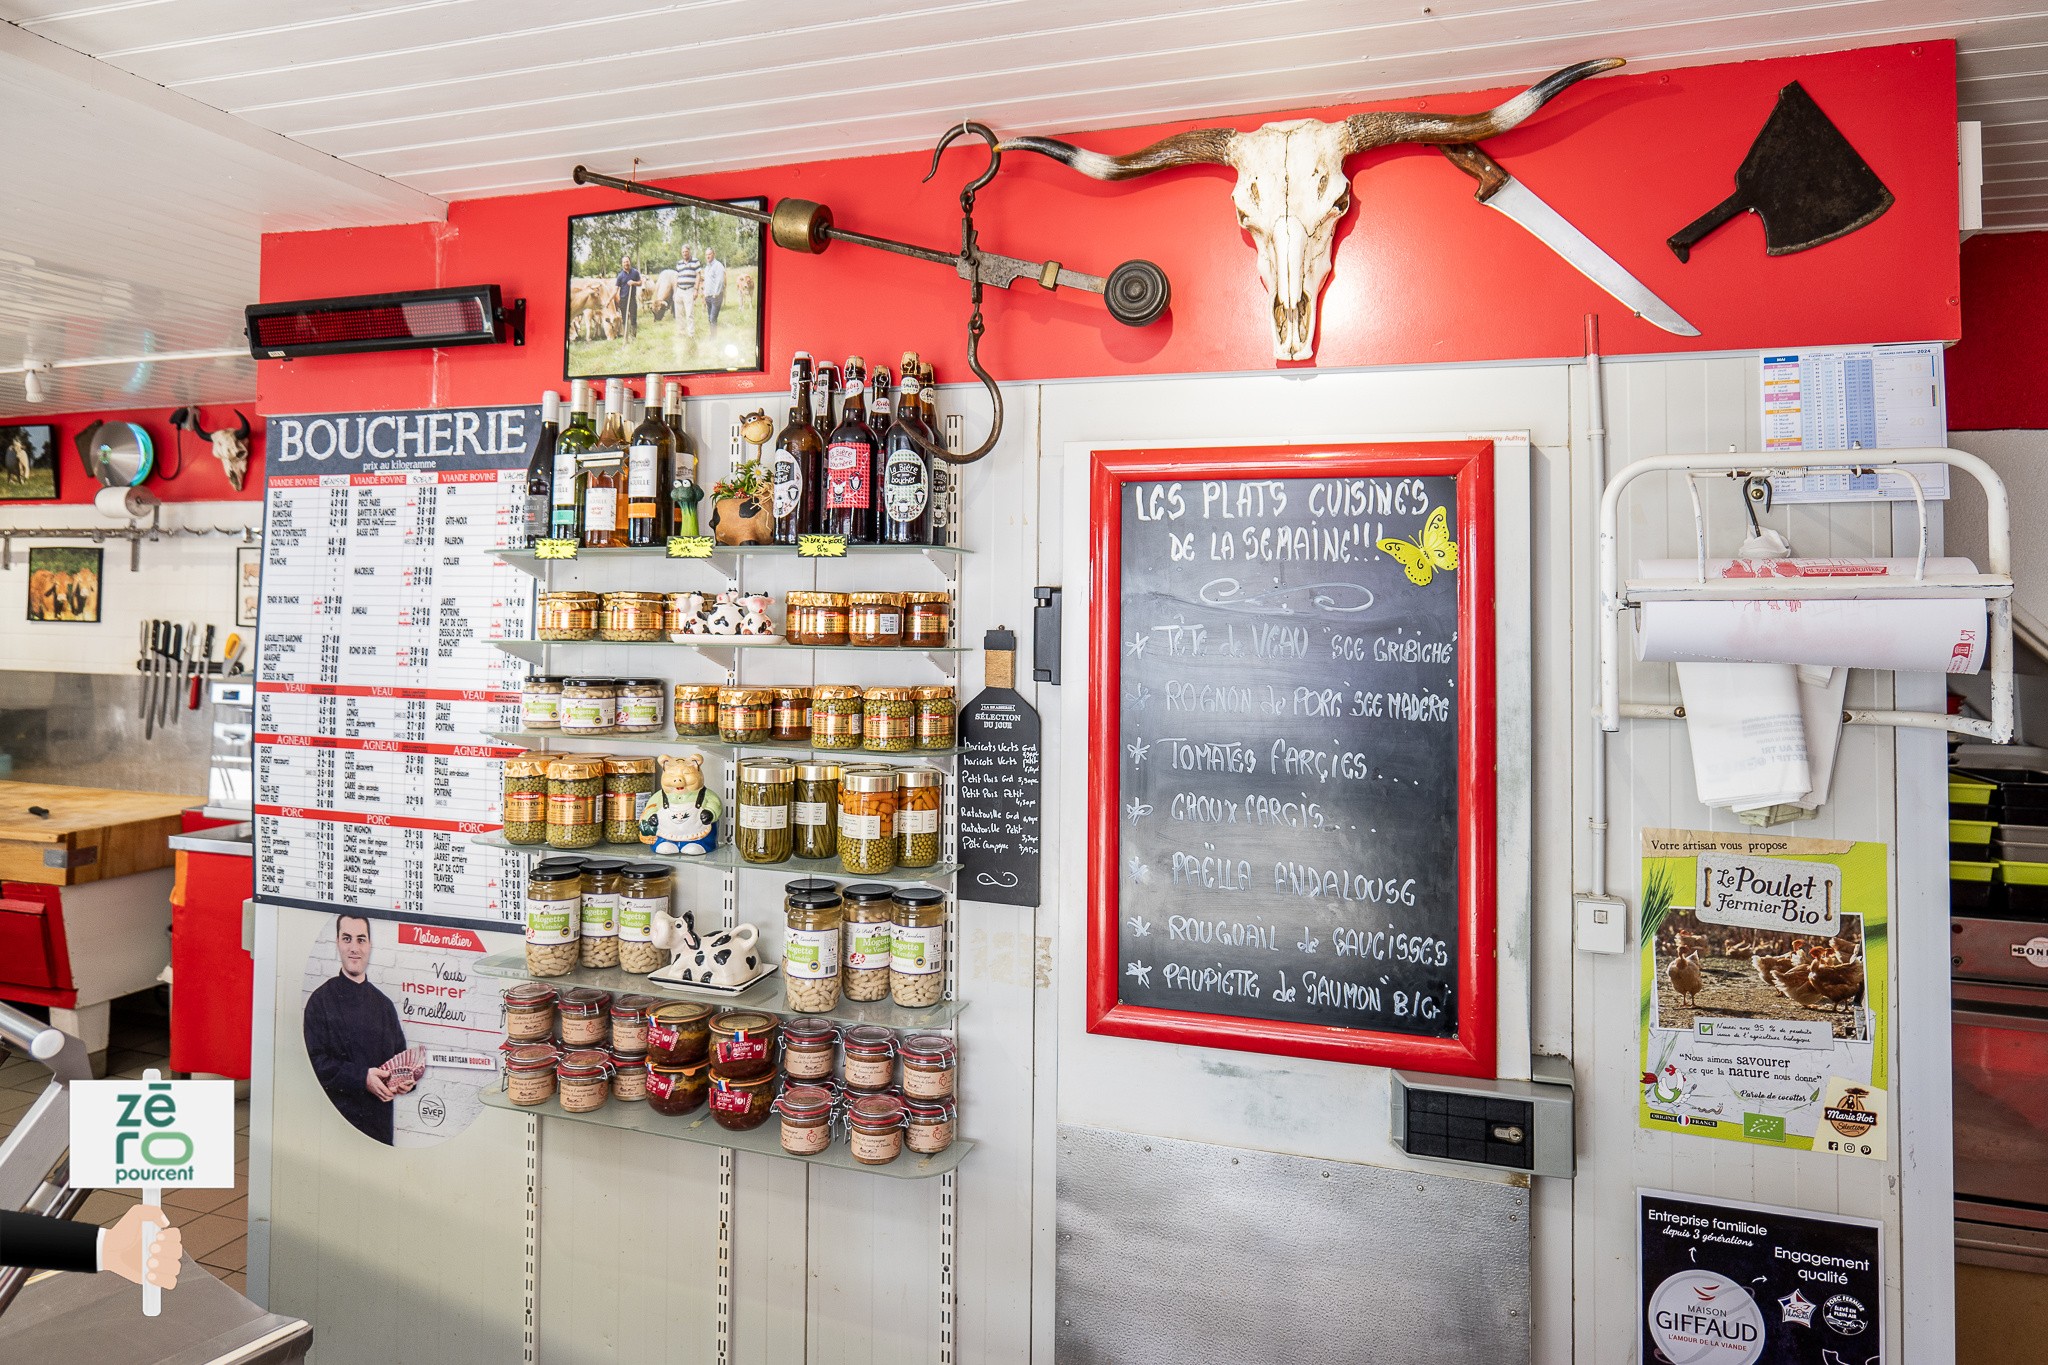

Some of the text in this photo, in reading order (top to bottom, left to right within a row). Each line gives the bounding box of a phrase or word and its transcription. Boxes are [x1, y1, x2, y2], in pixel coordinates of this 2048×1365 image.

[278, 410, 527, 462] BOUCHERIE
[362, 459, 436, 472] prix au kilogramme
[891, 463, 919, 475] La Bière
[270, 478, 319, 486] VIANDE BOVINE
[442, 473, 496, 482] VIANDE BOVINE
[1136, 482, 1186, 520] LES
[1203, 480, 1287, 519] PLATS
[1169, 532, 1195, 561] DE
[1211, 530, 1235, 561] LA
[1252, 624, 1309, 658] VEAU
[285, 683, 306, 692] VEAU
[371, 687, 393, 695] VEAU
[463, 691, 485, 700] VEAU
[1164, 680, 1251, 712] ROGNON
[1260, 685, 1286, 715] de
[975, 712, 1021, 721] SÉLECTION
[277, 736, 311, 745] AGNEAU
[362, 741, 399, 751] AGNEAU
[454, 746, 492, 756] AGNEAU
[1156, 738, 1256, 774] TOMATES
[962, 771, 981, 783] Petit
[962, 786, 980, 798] Petit
[982, 788, 998, 798] Pois
[282, 807, 304, 817] PORC
[1171, 792, 1238, 824] CHOUX
[366, 814, 391, 825] PORC
[459, 822, 484, 833] PORC
[1652, 840, 1680, 850] Votre
[1683, 842, 1717, 850] artisan
[1749, 841, 1788, 853] propose
[1717, 866, 1816, 899] Le Poulet
[1716, 893, 1820, 925] Fermier Bio
[533, 914, 565, 922] Mogette
[413, 927, 472, 947] Notre métier
[1297, 926, 1319, 954] de
[2018, 947, 2048, 956] BON
[432, 962, 466, 982] Vous
[1163, 962, 1261, 998] PAUPIETTE
[1273, 970, 1296, 1003] de
[403, 997, 466, 1021] le meilleur
[1707, 1055, 1733, 1064] aimons
[1736, 1055, 1791, 1068] savourer
[1701, 1069, 1715, 1077] que
[1717, 1067, 1725, 1075] la
[1728, 1066, 1770, 1079] nature
[1773, 1073, 1792, 1081] nous
[1740, 1089, 1765, 1099] Parole
[1777, 1092, 1806, 1102] cocottes
[1651, 1113, 1717, 1127] ORIGINE FRANCE
[1827, 1109, 1855, 1120] Marie
[1836, 1122, 1866, 1131] Sélection
[1648, 1209, 1767, 1236] Entreprise familiale
[1662, 1225, 1754, 1247] depuis 3 générations
[1774, 1247, 1870, 1272] Engagement
[1797, 1269, 1848, 1285] qualité
[1687, 1304, 1727, 1317] MAISON
[1655, 1310, 1758, 1343] GIFFAUD
[1668, 1334, 1698, 1344] L'AMOUR
[1710, 1340, 1719, 1348] LA
[1721, 1342, 1747, 1352] VIANDE
